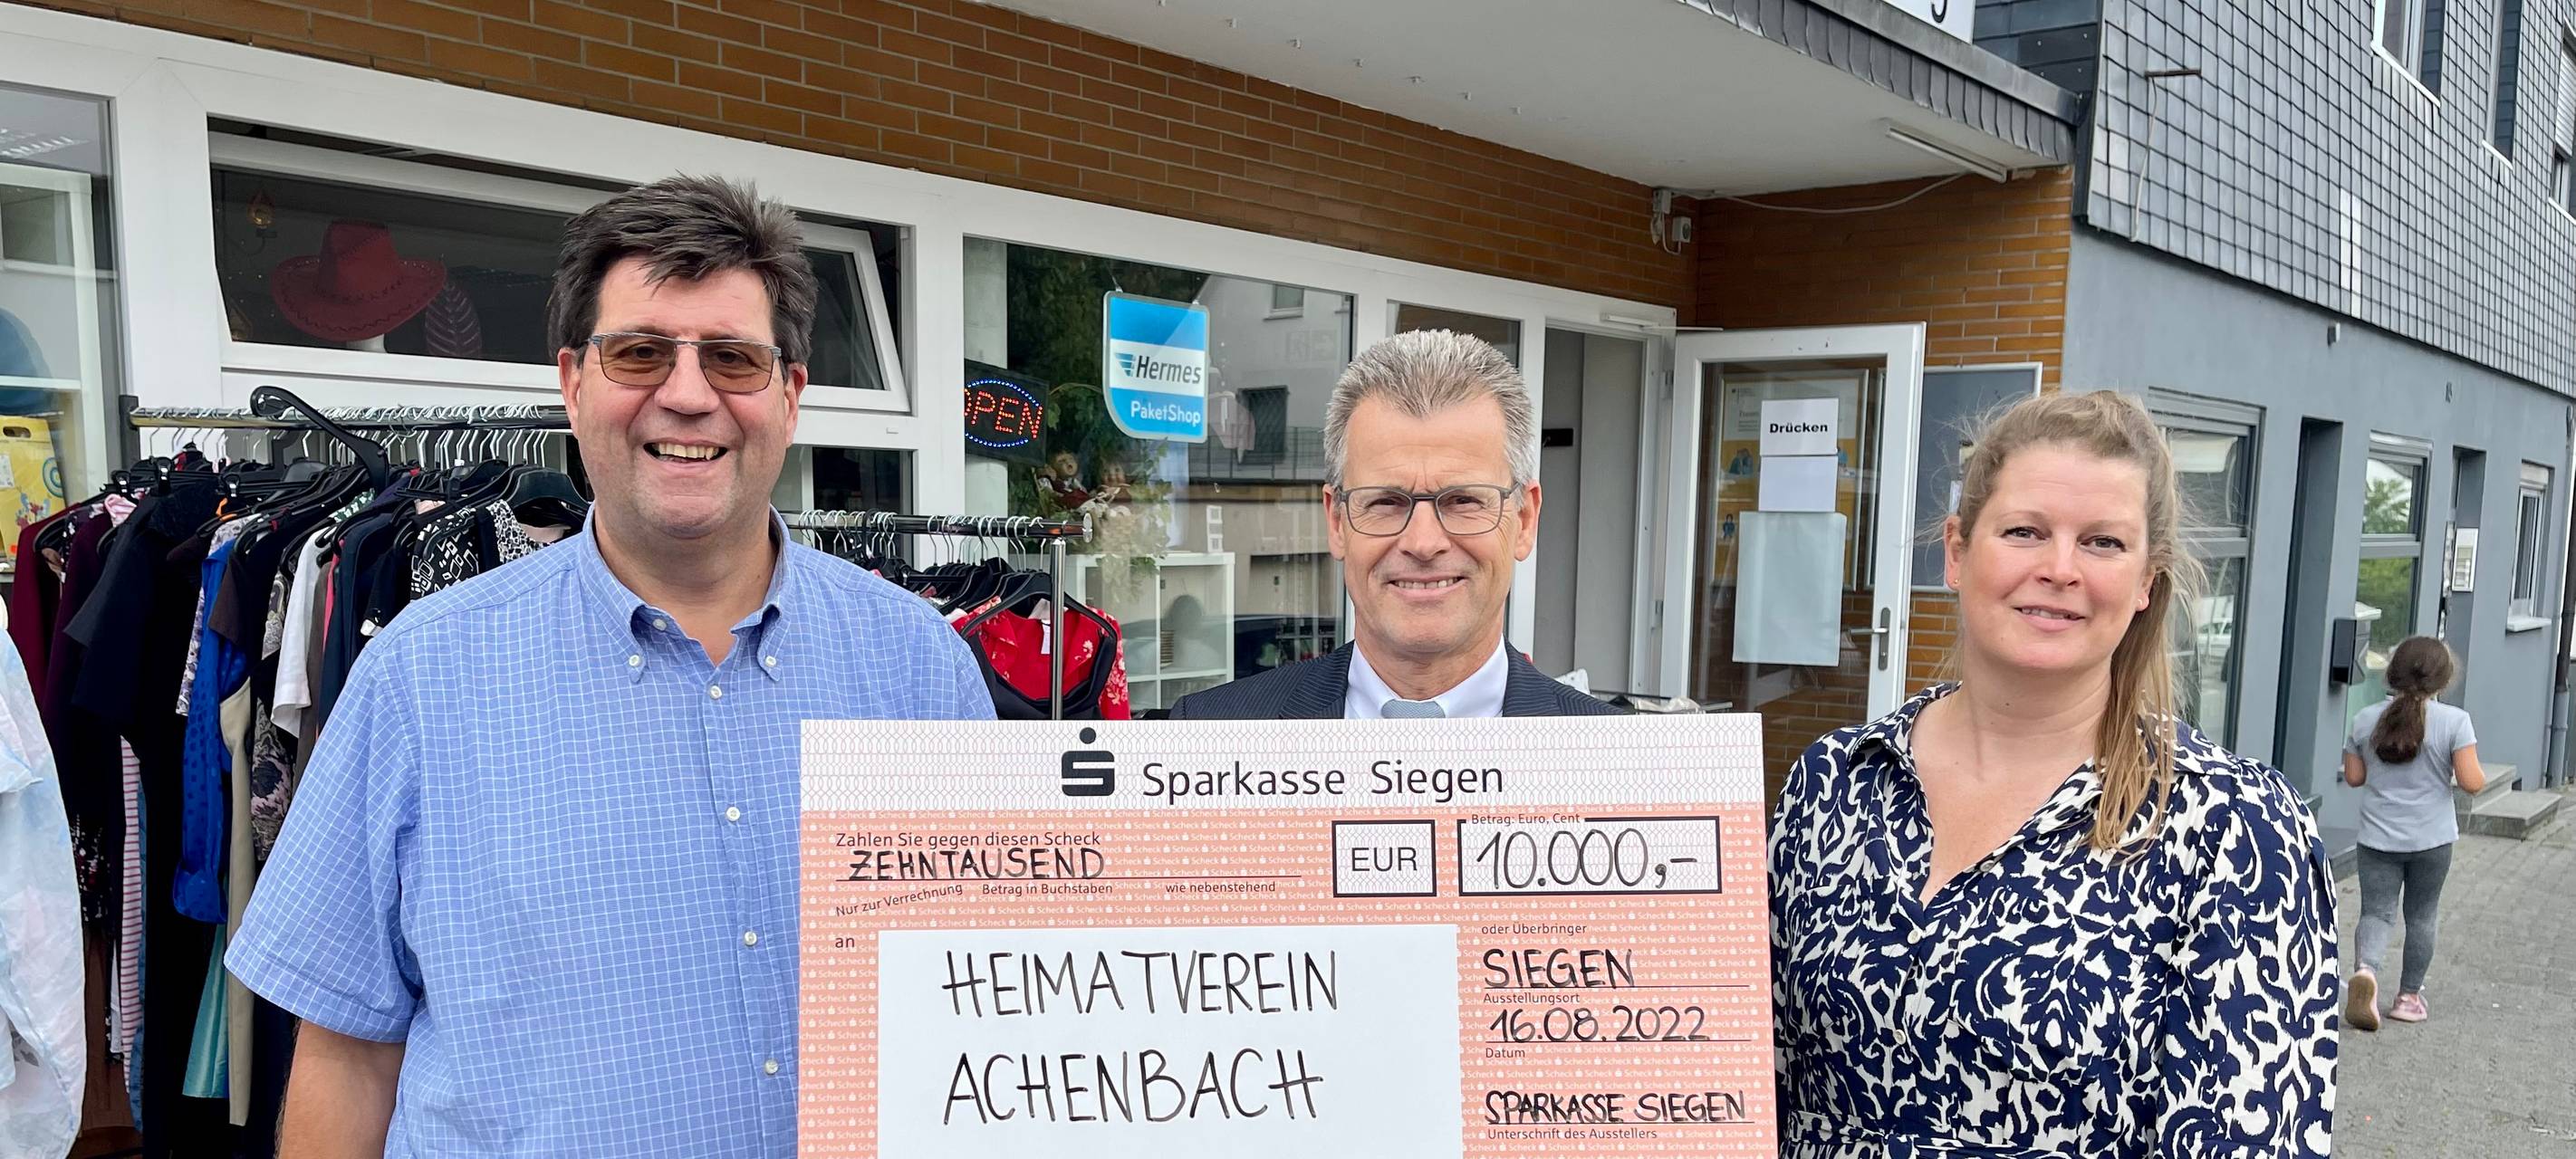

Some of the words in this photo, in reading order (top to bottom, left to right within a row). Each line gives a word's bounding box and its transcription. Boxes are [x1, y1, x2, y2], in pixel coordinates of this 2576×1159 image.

[1135, 354, 1203, 384] Hermes
[1130, 400, 1202, 427] PaketShop
[1769, 422, 1828, 434] Drücken
[1143, 761, 1345, 806] Sparkasse
[1371, 760, 1503, 803] Siegen
[1471, 813, 1514, 827] Betrag:
[1518, 812, 1550, 826] Euro,
[1552, 812, 1580, 823] Cent
[836, 831, 892, 847] Zahlen
[898, 832, 923, 847] Sie
[928, 835, 979, 850] gegen
[985, 831, 1039, 846] diesen
[1044, 831, 1101, 846] Scheck
[848, 845, 1108, 881] ZEHNTAUSEND
[1351, 847, 1418, 872] EUR
[982, 884, 1023, 897] Betrag
[1025, 884, 1038, 895] in
[1041, 883, 1113, 894] Buchstaben
[1166, 885, 1187, 893] wie
[1189, 881, 1275, 893] nebenstehend
[836, 905, 859, 915] Nur
[862, 900, 880, 912] zur
[883, 885, 963, 906] Verrechnung
[1481, 924, 1509, 934] oder
[1513, 923, 1587, 936] Überbringer
[835, 937, 855, 949] an
[1483, 948, 1636, 988] SIEGEN
[942, 950, 1337, 1018] HEIMATVEREIN
[1484, 991, 1580, 1006] Ausstellungsort
[1489, 1004, 1711, 1041] 16.08.2022
[1485, 1048, 1525, 1058] Datum
[943, 1048, 1324, 1125] ACHENBACH
[1485, 1089, 1626, 1123] SPARKASSE
[1634, 1089, 1746, 1123] SIEGEN
[1488, 1127, 1560, 1140] Unterschrift
[1564, 1128, 1586, 1139] des
[1589, 1127, 1658, 1139] Ausstellers
